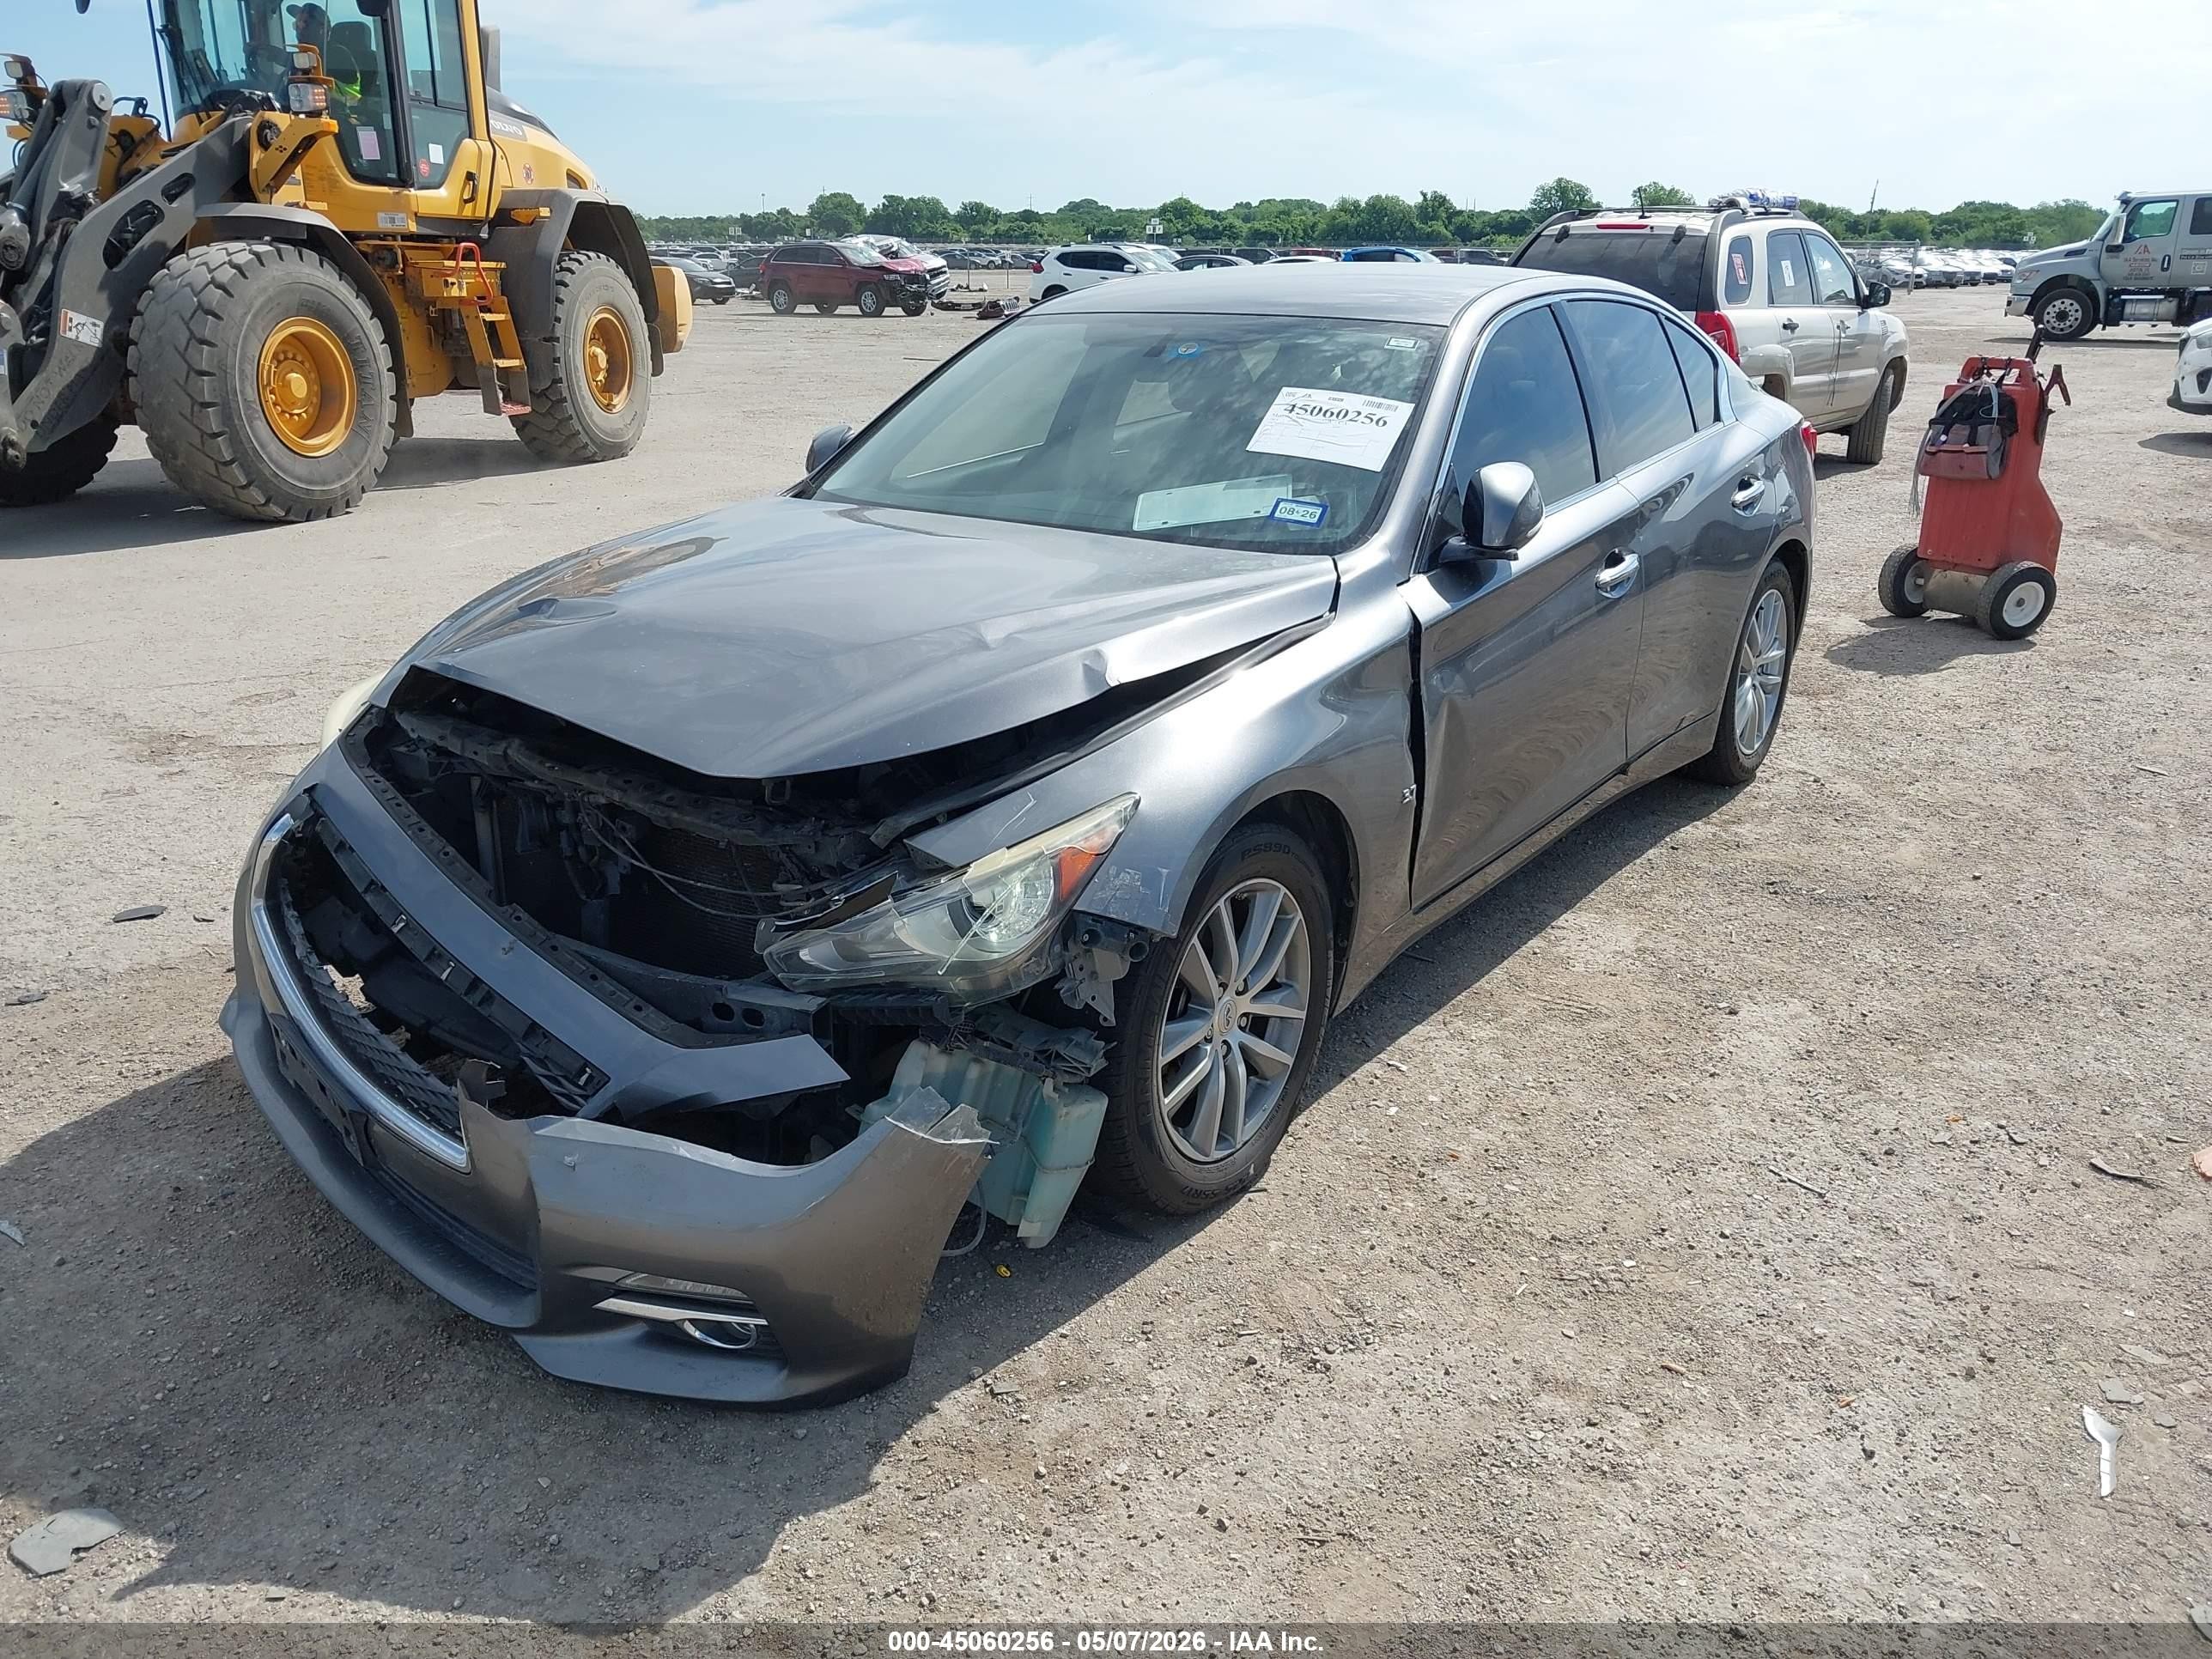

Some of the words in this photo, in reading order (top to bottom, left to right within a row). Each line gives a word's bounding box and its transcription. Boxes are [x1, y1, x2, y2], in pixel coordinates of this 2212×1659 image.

[348, 334, 375, 438] TITAN
[1284, 402, 1389, 428] 45060256
[1279, 506, 1296, 516] 08
[1300, 509, 1318, 520] 26
